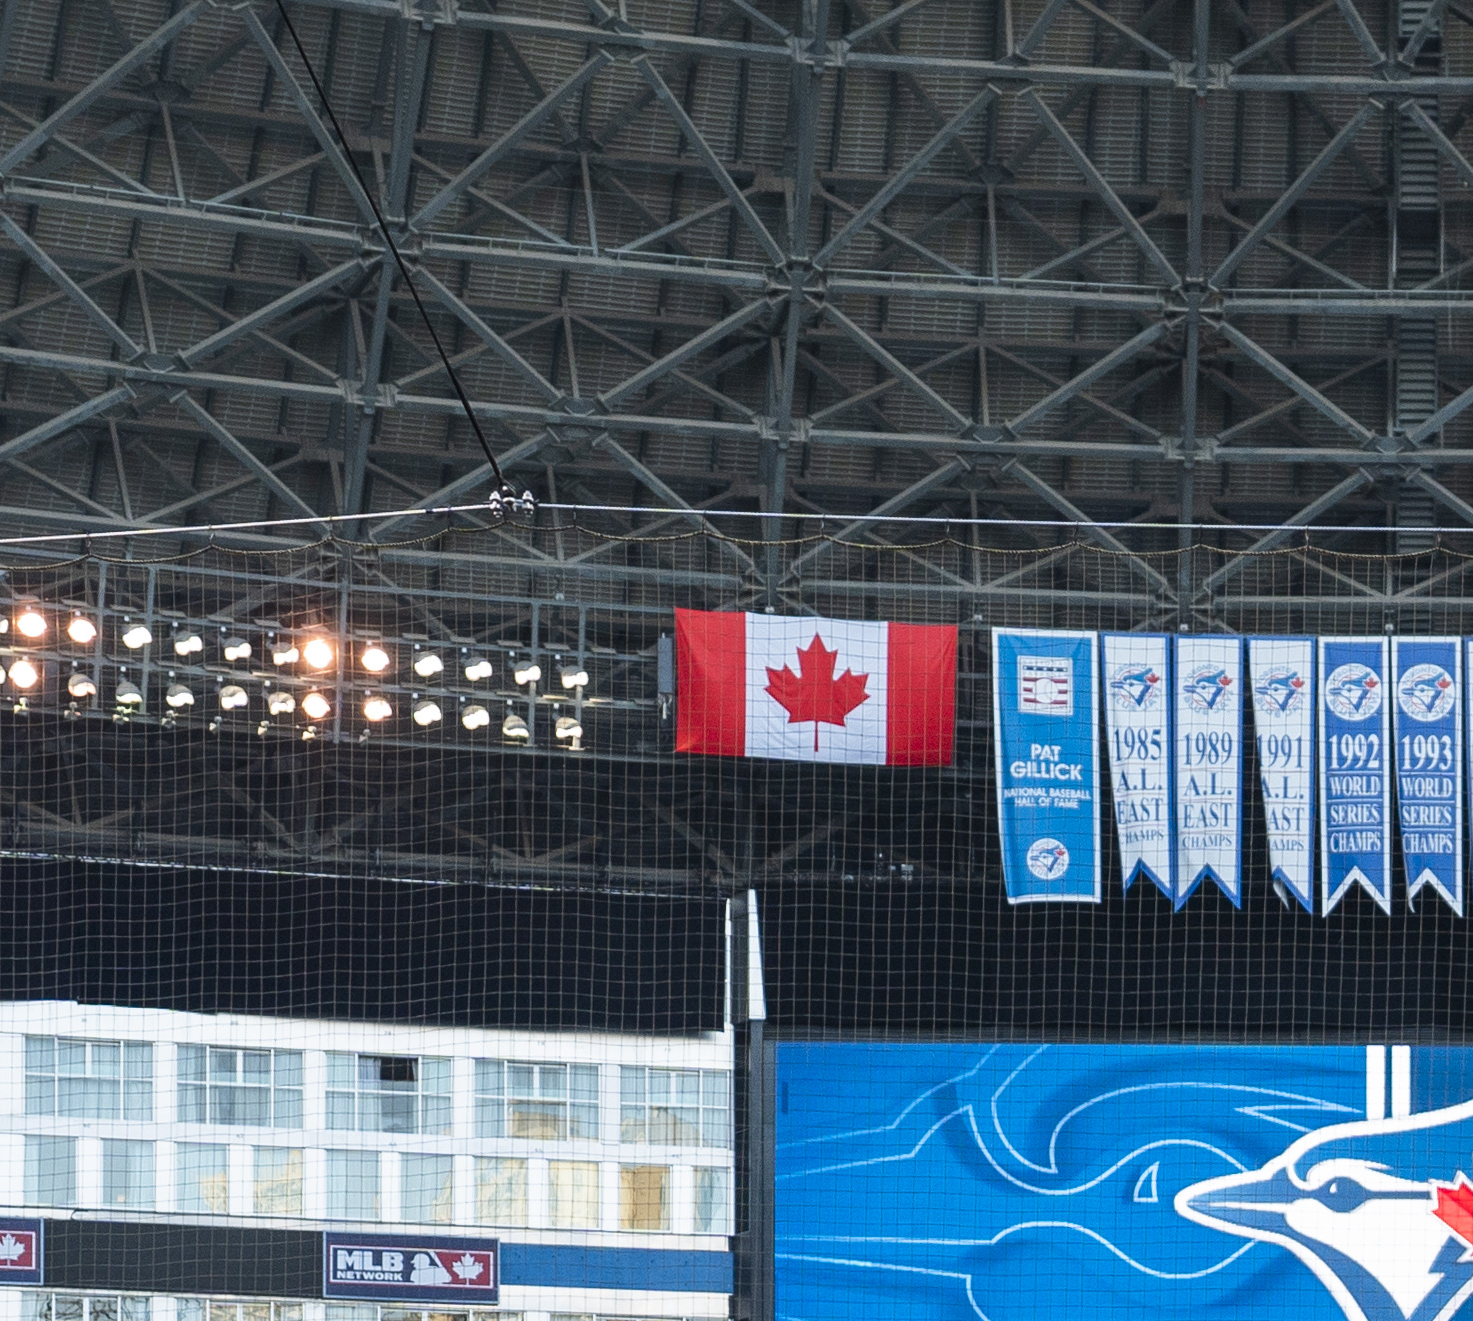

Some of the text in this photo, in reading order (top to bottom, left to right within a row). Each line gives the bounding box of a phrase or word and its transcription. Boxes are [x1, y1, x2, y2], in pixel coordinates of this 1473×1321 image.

[1030, 743, 1061, 760] PAT
[1113, 728, 1162, 763] 1985
[1184, 731, 1233, 766] 1989
[1257, 734, 1303, 768] 1991
[1328, 734, 1379, 769] 1992
[1401, 734, 1452, 770] 1993
[1010, 761, 1082, 781] GILLICK
[1116, 767, 1163, 793] A.L.
[1048, 788, 1091, 800] BASEBALL
[1184, 773, 1232, 796] A.L.
[1261, 776, 1304, 799] A.L.
[1329, 776, 1380, 796] WORLD
[1401, 777, 1453, 797] WORLD
[1038, 797, 1051, 808] OF
[1118, 797, 1164, 825] EAST
[1183, 802, 1233, 829] EAST
[1330, 804, 1380, 825] SERIES
[1402, 806, 1452, 826] SERIES
[1182, 834, 1232, 849] CHAMPS
[1330, 832, 1381, 852] CHAMPS
[1402, 832, 1453, 853] CHAMPS
[336, 1250, 404, 1272] MLB
[336, 1270, 404, 1282] NETWORK
